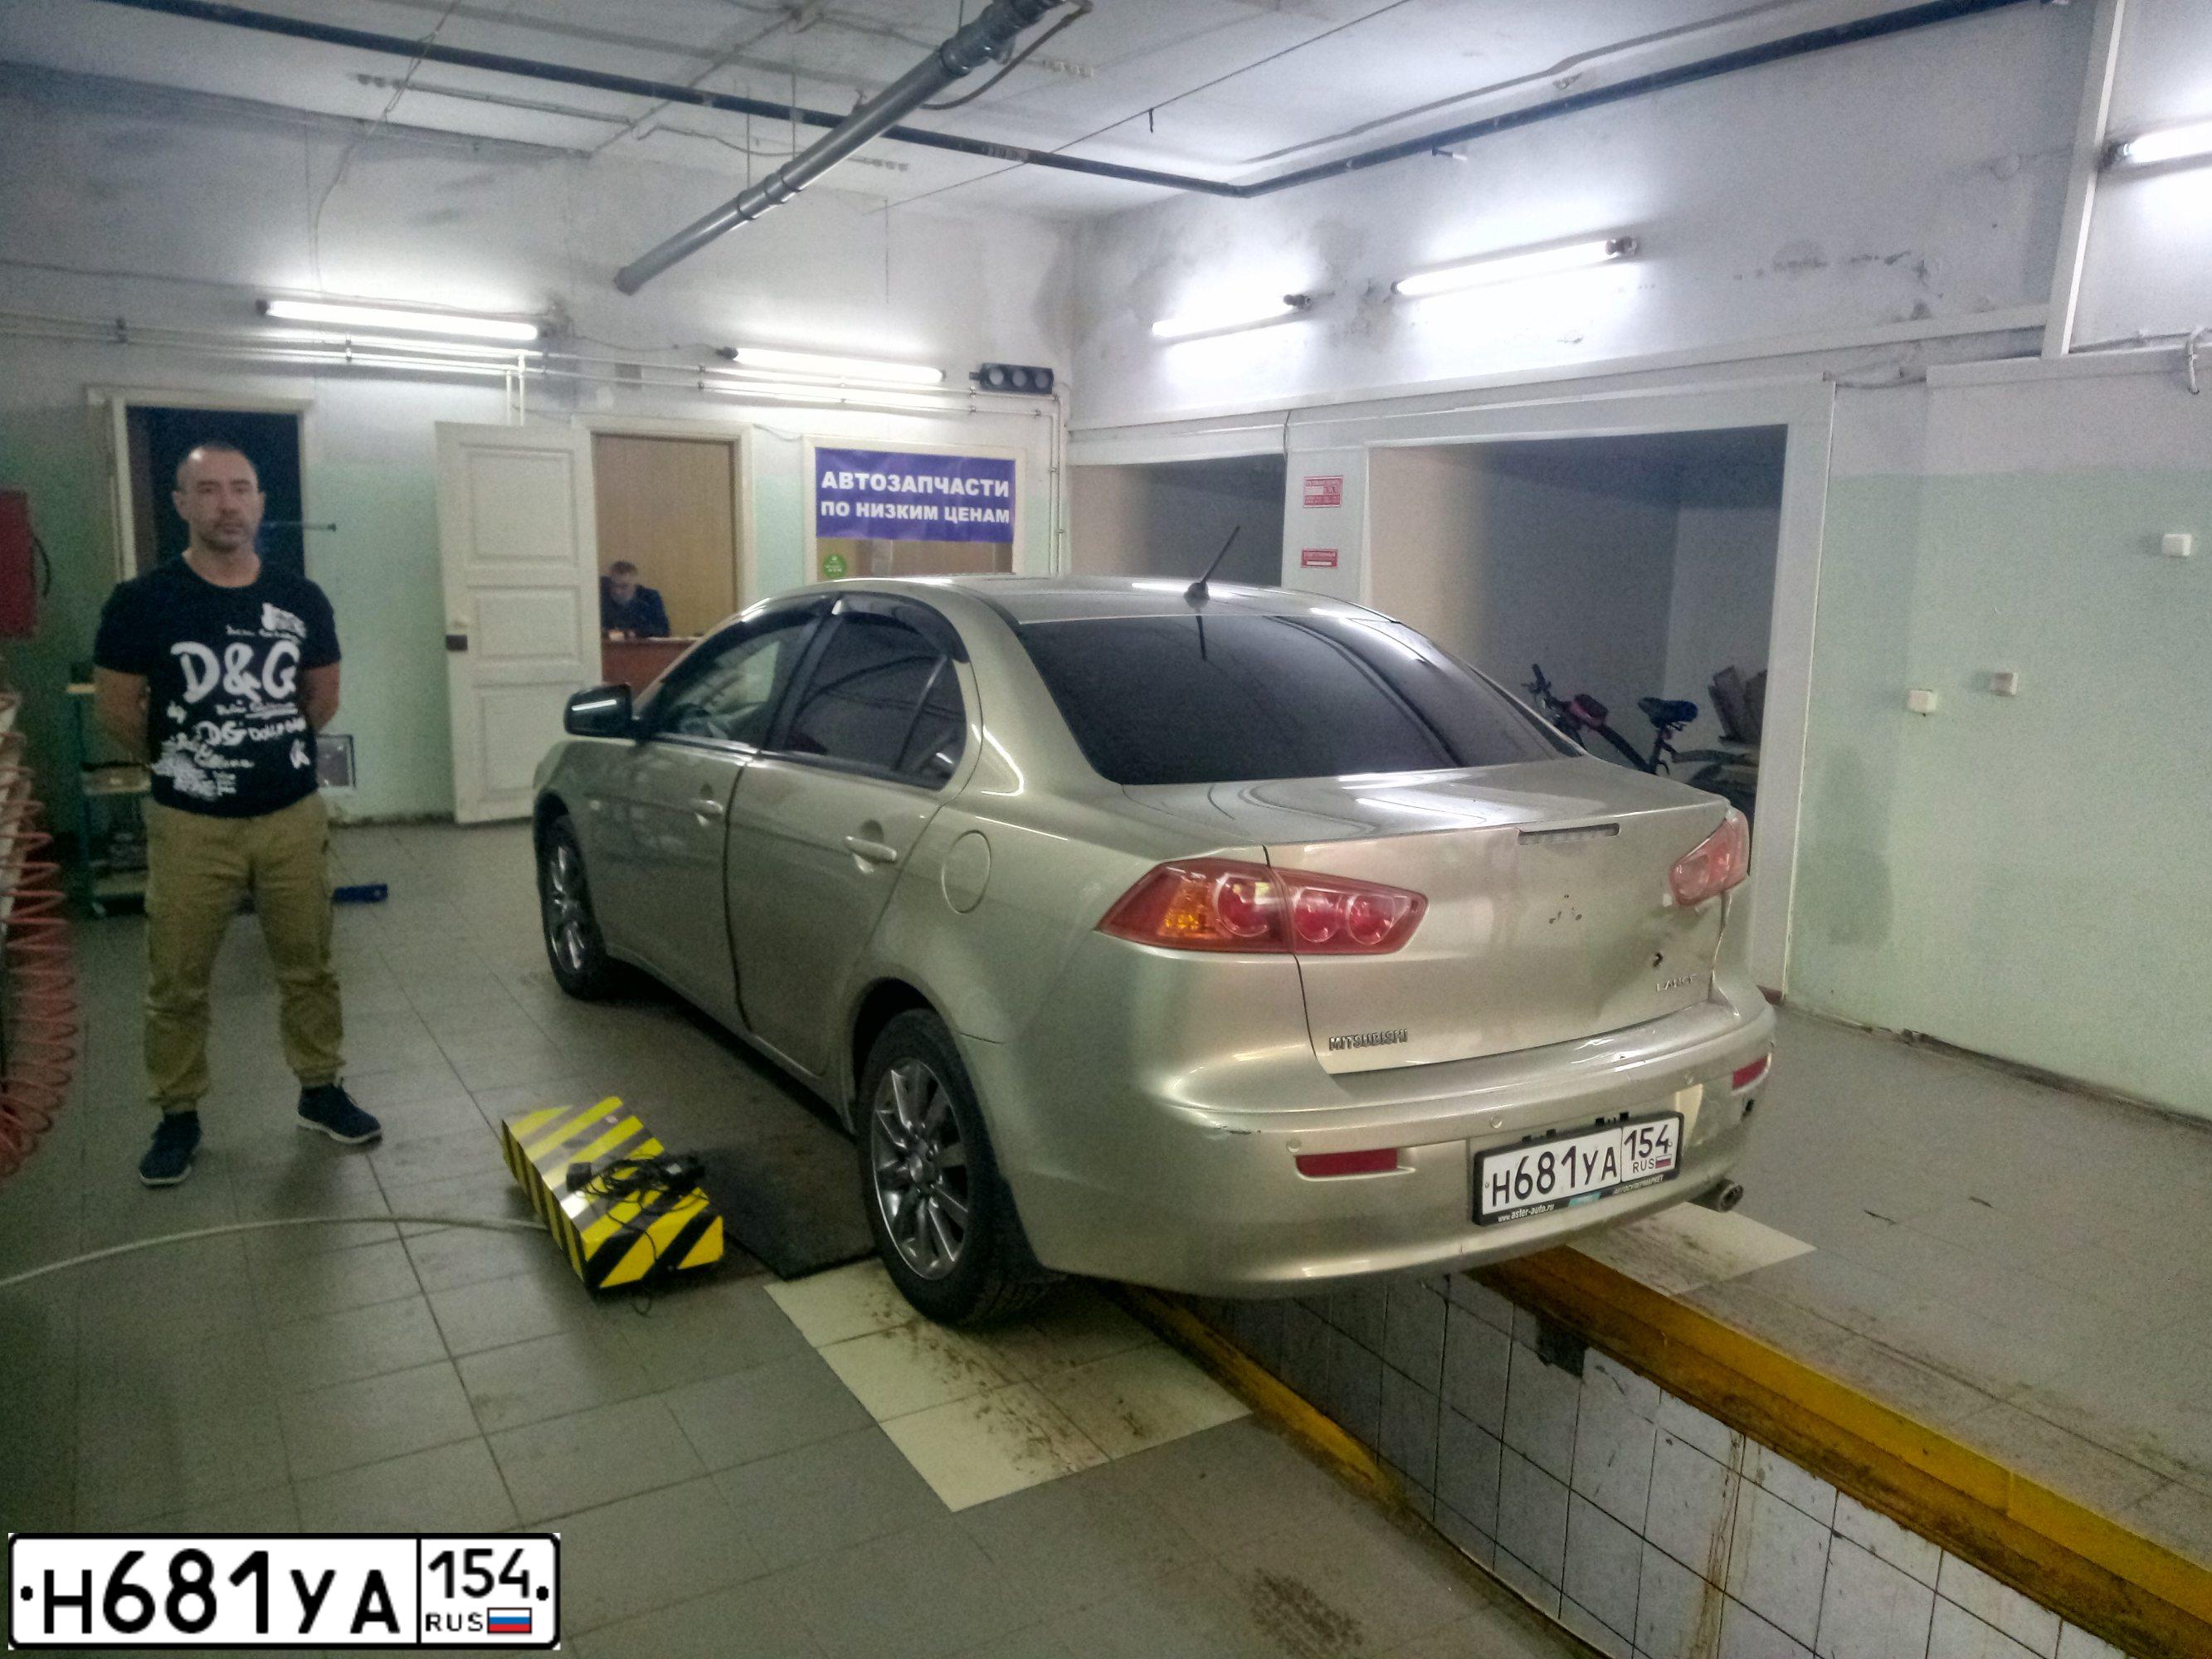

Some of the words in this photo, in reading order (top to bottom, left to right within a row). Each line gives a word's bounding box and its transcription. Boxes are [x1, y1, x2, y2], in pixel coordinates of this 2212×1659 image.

[821, 470, 1010, 499] АВТОЗАПЧАСТИ
[821, 501, 850, 518] ПО
[855, 502, 939, 522] НИЗКИМ
[944, 506, 1011, 524] ЦЕНАМ
[170, 640, 301, 703] D&G
[1328, 1028, 1409, 1052] MITSUBISHI
[1623, 1123, 1671, 1161] 154
[1632, 1158, 1655, 1174] RUS
